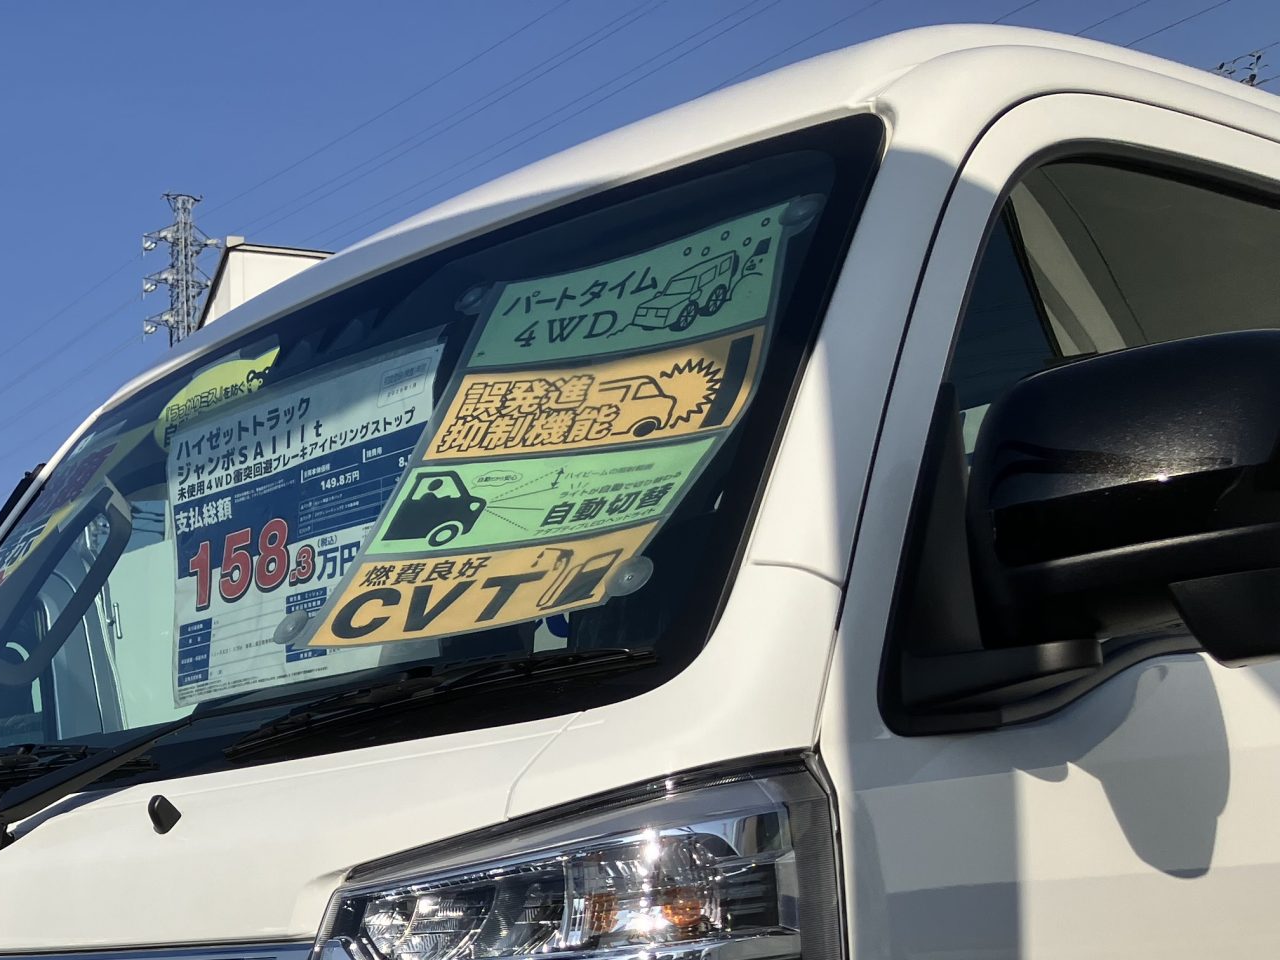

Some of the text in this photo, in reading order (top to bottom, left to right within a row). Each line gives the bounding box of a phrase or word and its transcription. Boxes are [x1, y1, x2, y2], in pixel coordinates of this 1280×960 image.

[502, 266, 658, 316] パートタイム
[513, 310, 618, 349] 4WD
[455, 374, 596, 420] 誤発進
[176, 396, 311, 460] ハイゼットトラック
[436, 403, 621, 453] 抑制機能
[320, 470, 360, 491] 149.8万円
[175, 495, 233, 535] 支払総額
[540, 482, 675, 528] 自動切替
[359, 556, 493, 588] 燃費良好
[330, 569, 550, 640] CVT
